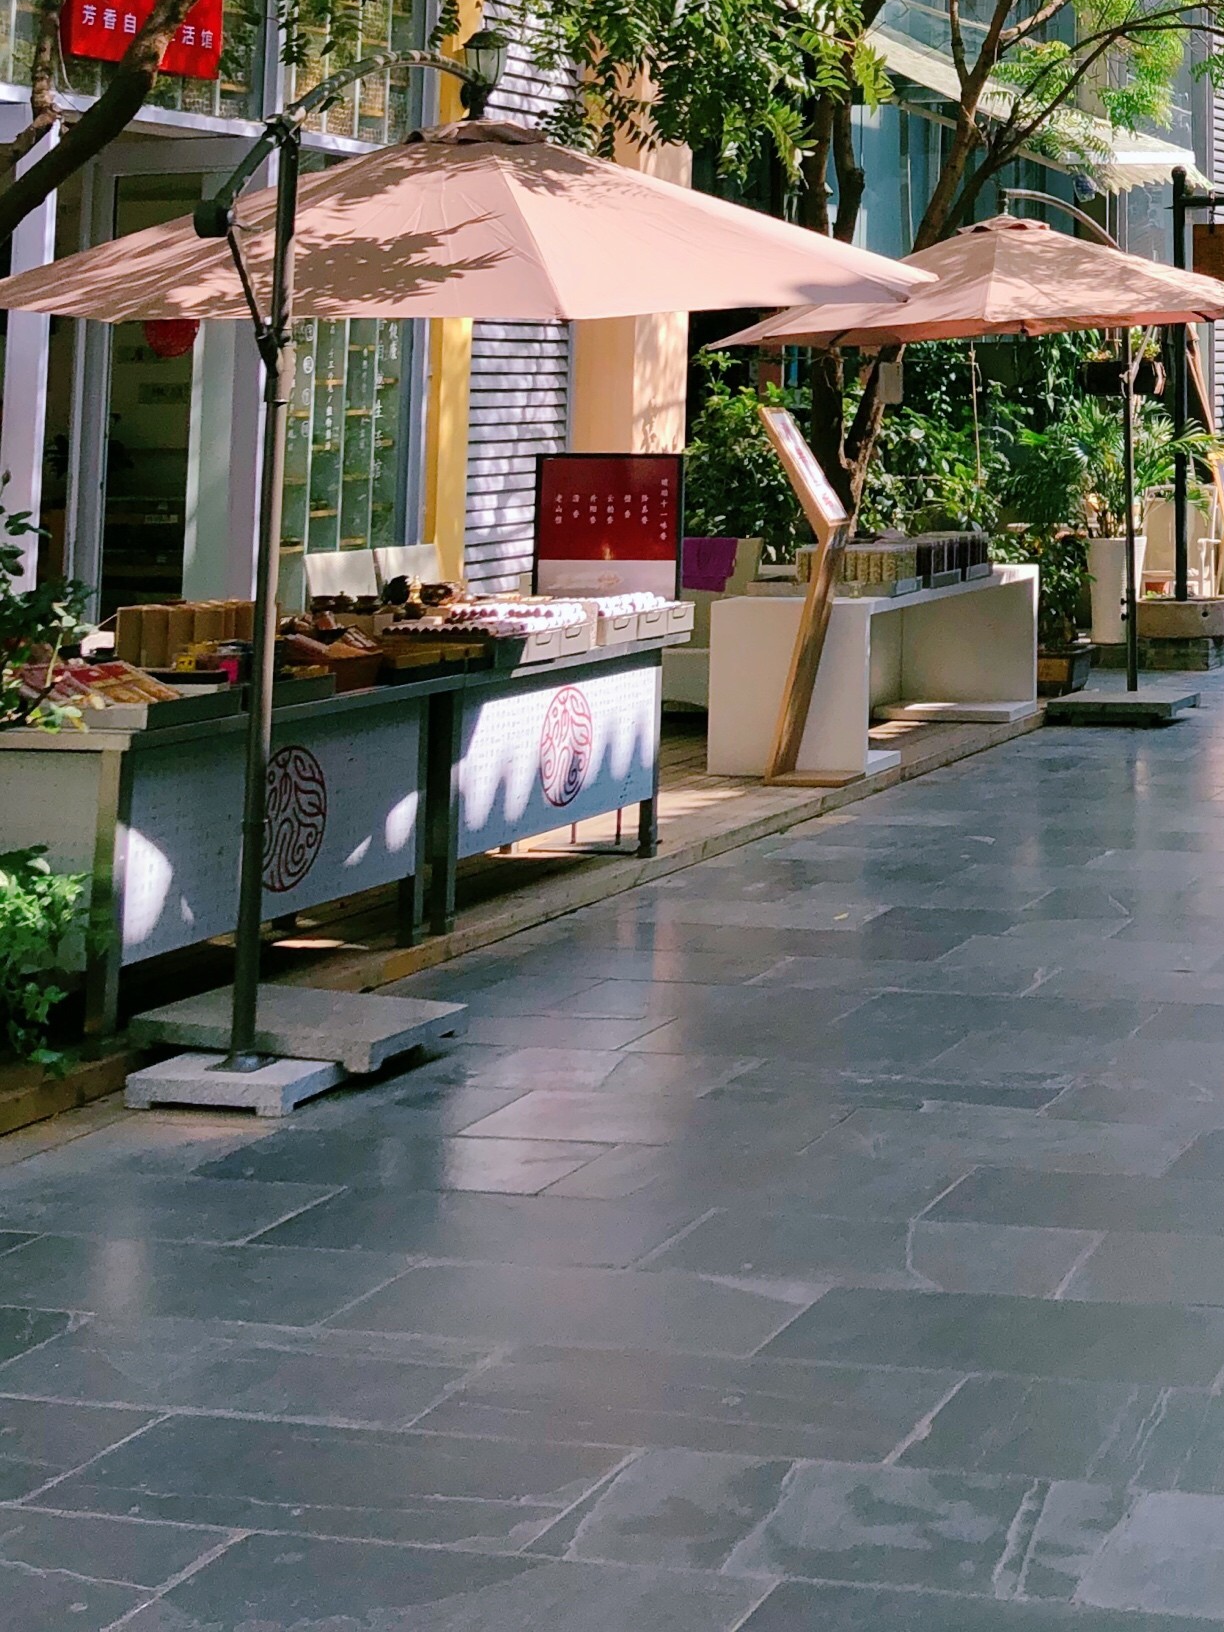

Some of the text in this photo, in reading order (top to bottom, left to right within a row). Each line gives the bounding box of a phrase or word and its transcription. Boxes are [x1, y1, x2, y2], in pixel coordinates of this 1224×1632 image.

[82, 4, 214, 49] 芳香自活馆
